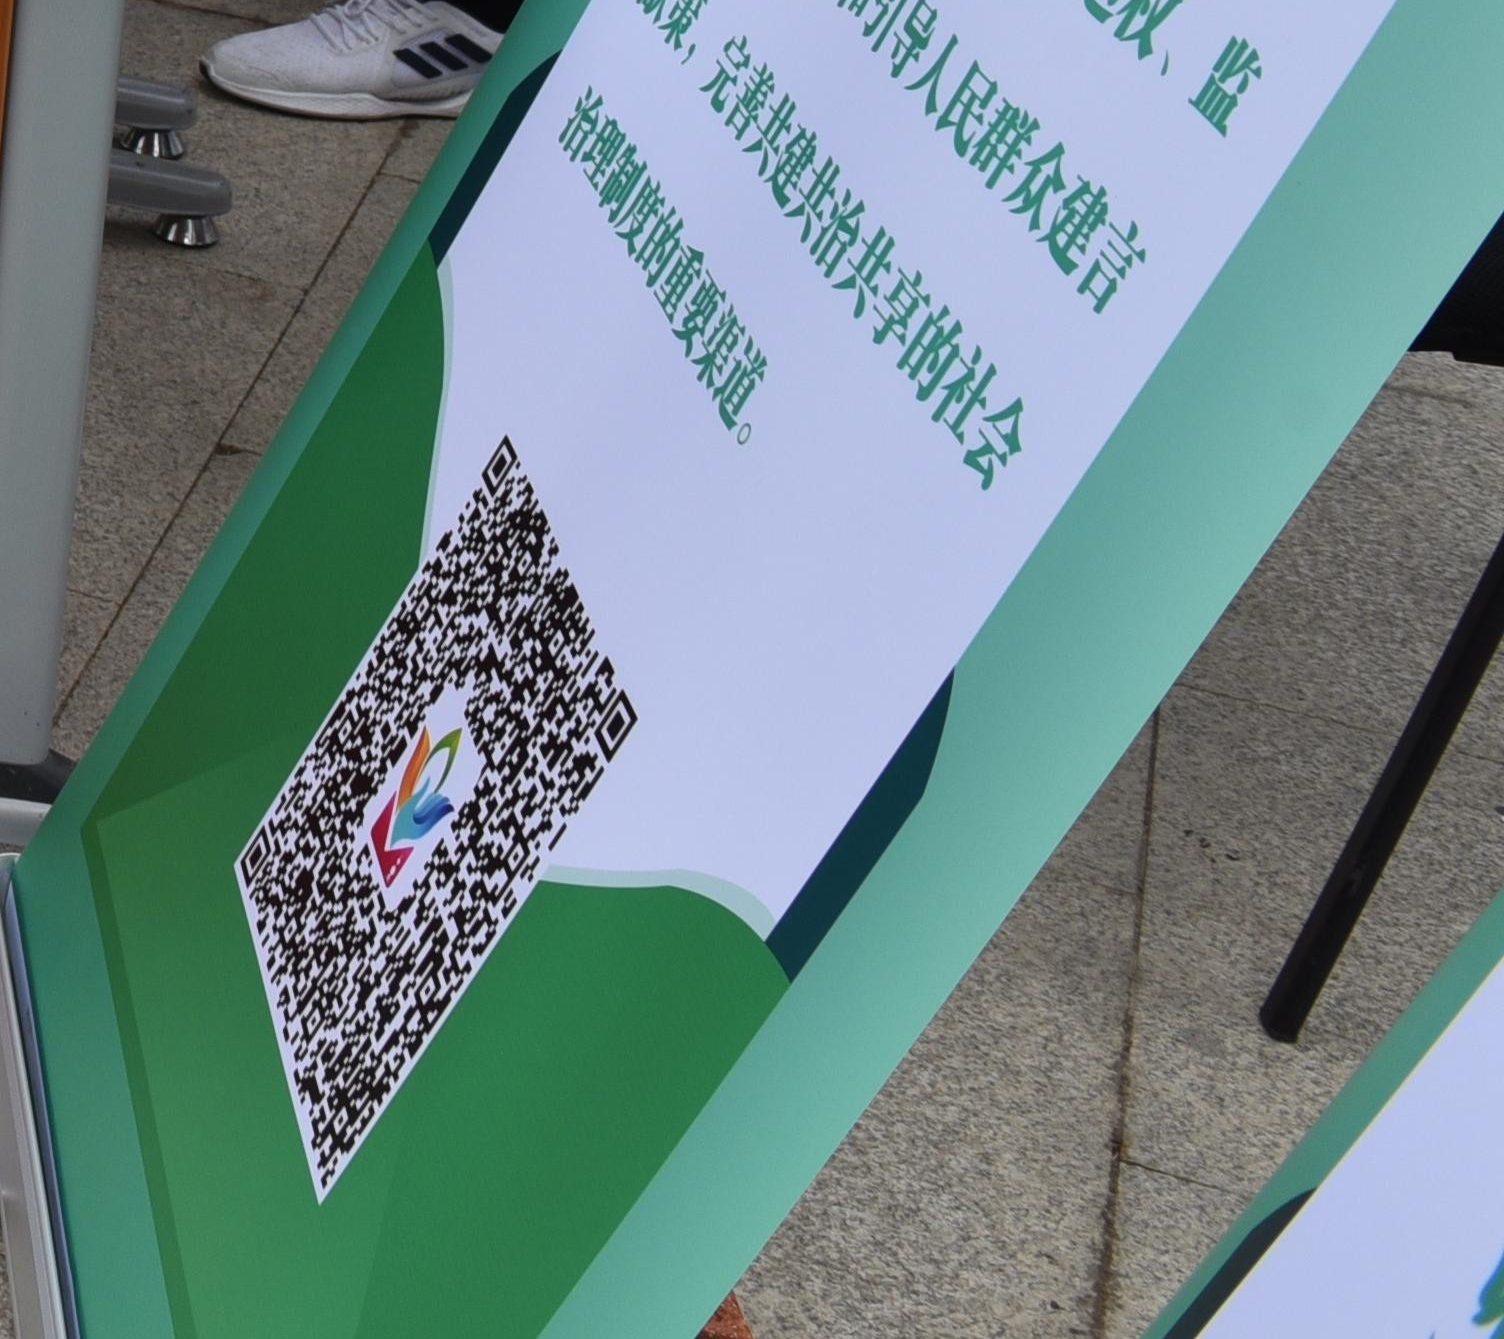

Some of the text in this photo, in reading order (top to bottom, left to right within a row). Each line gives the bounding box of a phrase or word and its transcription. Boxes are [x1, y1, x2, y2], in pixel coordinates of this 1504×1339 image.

[558, 84, 768, 445] 治理制度的重要渠道。
